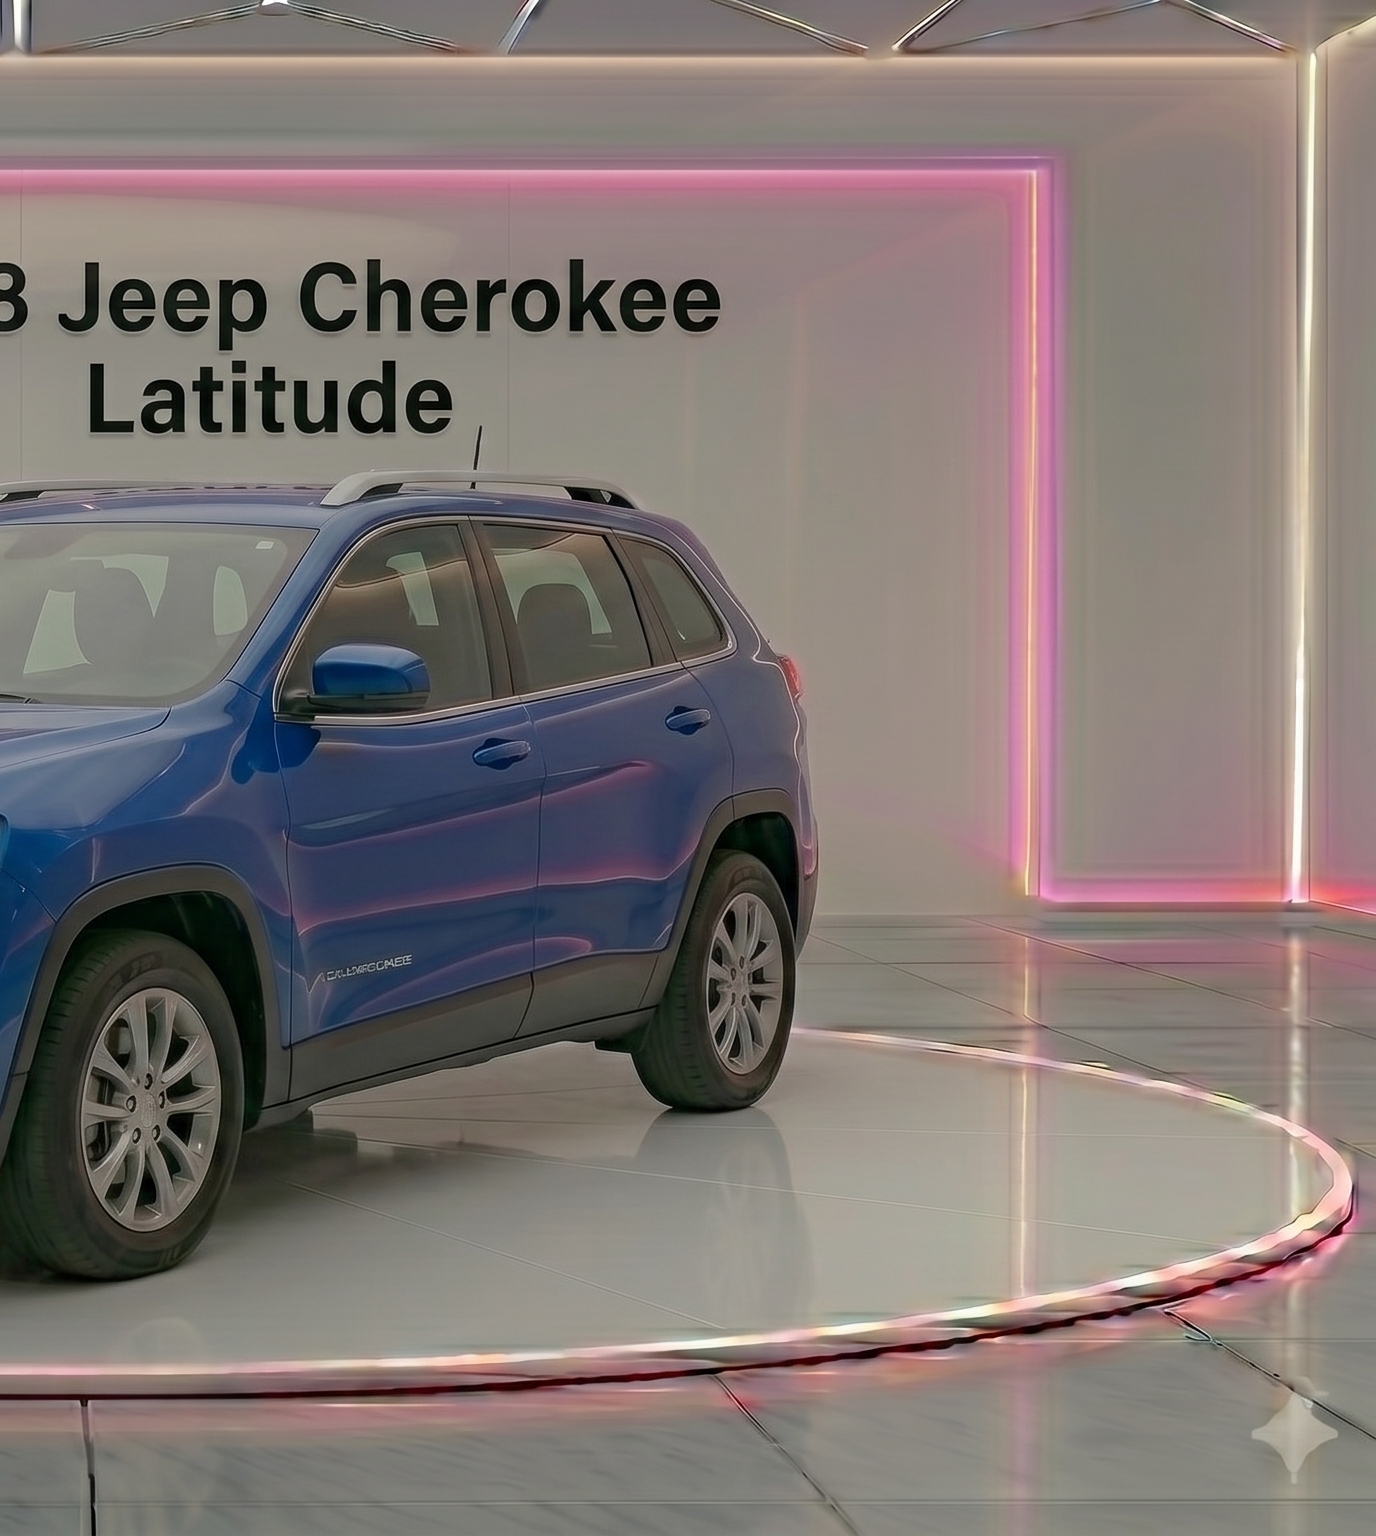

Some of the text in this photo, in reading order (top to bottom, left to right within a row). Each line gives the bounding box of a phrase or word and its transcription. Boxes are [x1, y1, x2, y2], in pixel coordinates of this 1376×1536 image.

[58, 261, 268, 351] Jeep
[299, 258, 722, 333] Cherokee
[89, 360, 453, 435] Latitude
